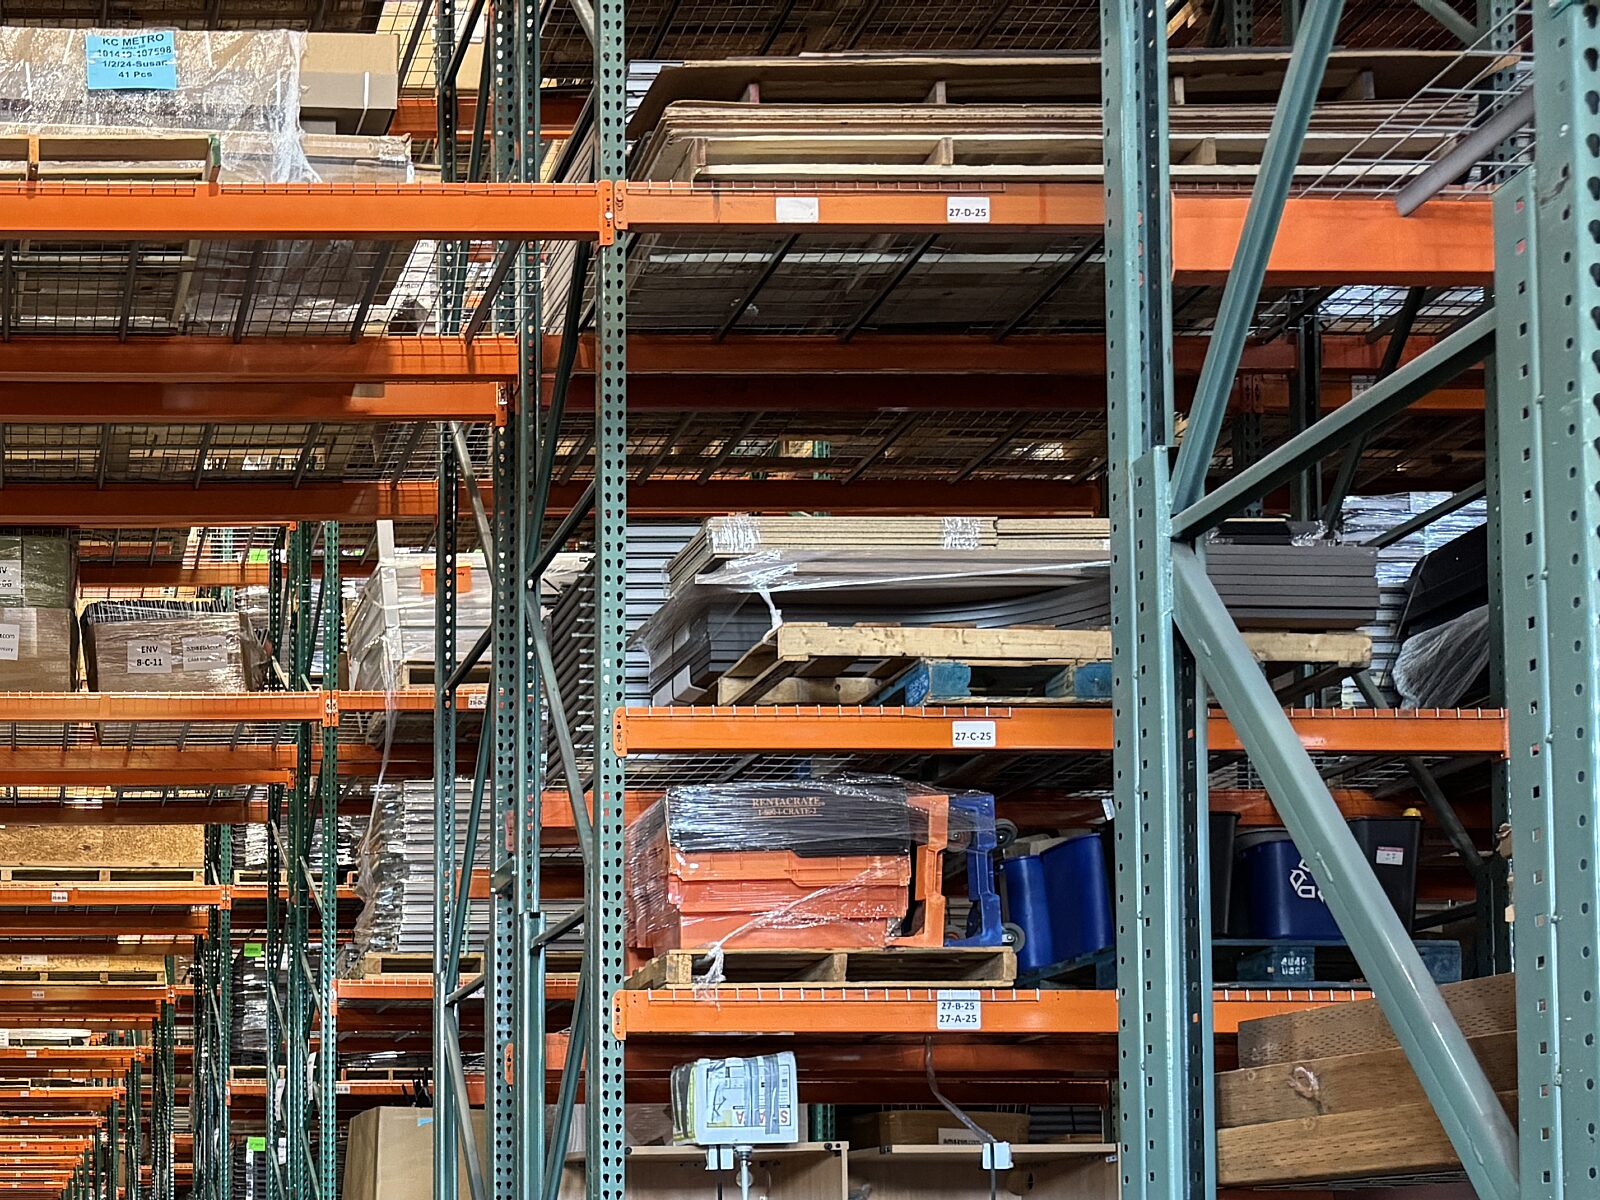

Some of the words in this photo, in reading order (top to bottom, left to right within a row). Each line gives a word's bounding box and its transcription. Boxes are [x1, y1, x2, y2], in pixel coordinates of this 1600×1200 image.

[102, 38, 119, 46] KC
[122, 33, 164, 46] METRO
[949, 208, 987, 217] 27-D-25
[141, 645, 159, 654] ENV
[136, 658, 163, 667] 8-C-11
[955, 732, 992, 741] 27-C-25
[941, 1001, 975, 1011] 27-B-25
[939, 1014, 977, 1023] 27-A-25
